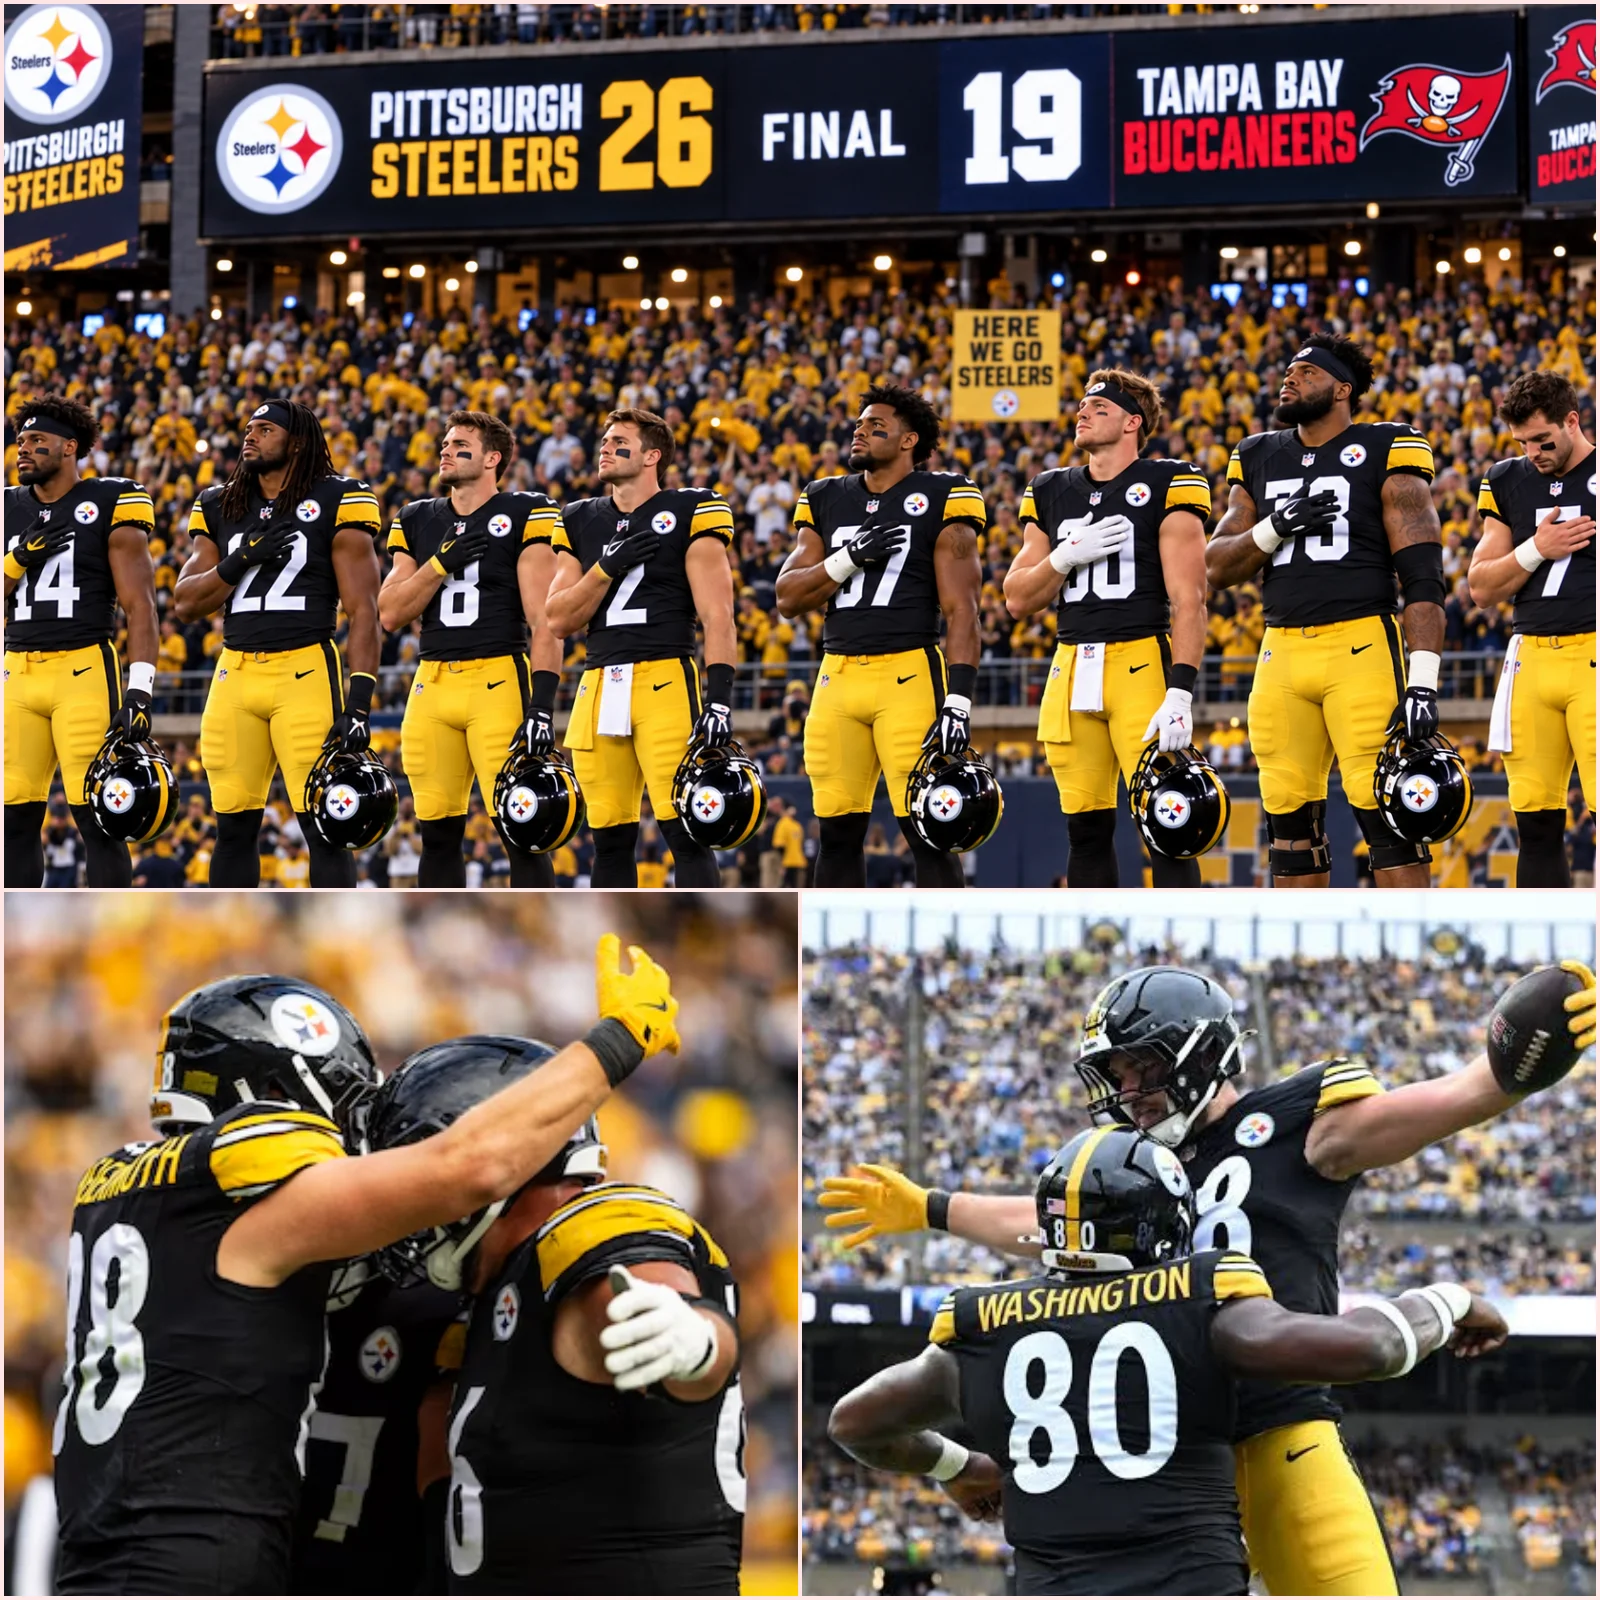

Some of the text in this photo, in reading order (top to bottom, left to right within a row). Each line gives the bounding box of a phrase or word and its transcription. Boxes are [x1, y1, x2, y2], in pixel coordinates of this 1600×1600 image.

[11, 55, 51, 70] Steelers
[1137, 59, 1343, 117] TAMPA BAY
[370, 84, 583, 138] PITTSBURGH
[600, 76, 713, 191] 26
[763, 108, 906, 161] FINAL
[963, 68, 1082, 184] 19
[1549, 121, 1596, 151] TAMPA
[233, 142, 277, 157] Steelers
[371, 136, 579, 198] STEELERS
[1123, 111, 1356, 175] BUCCANEERS
[970, 341, 1042, 362] WE GO
[973, 316, 1039, 338] HERE
[958, 365, 1053, 387] STEELERS
[1265, 476, 1350, 567] 73
[1535, 505, 1582, 598] 7
[977, 1263, 1191, 1333] WASHINGTON
[1003, 1321, 1178, 1494] 80
